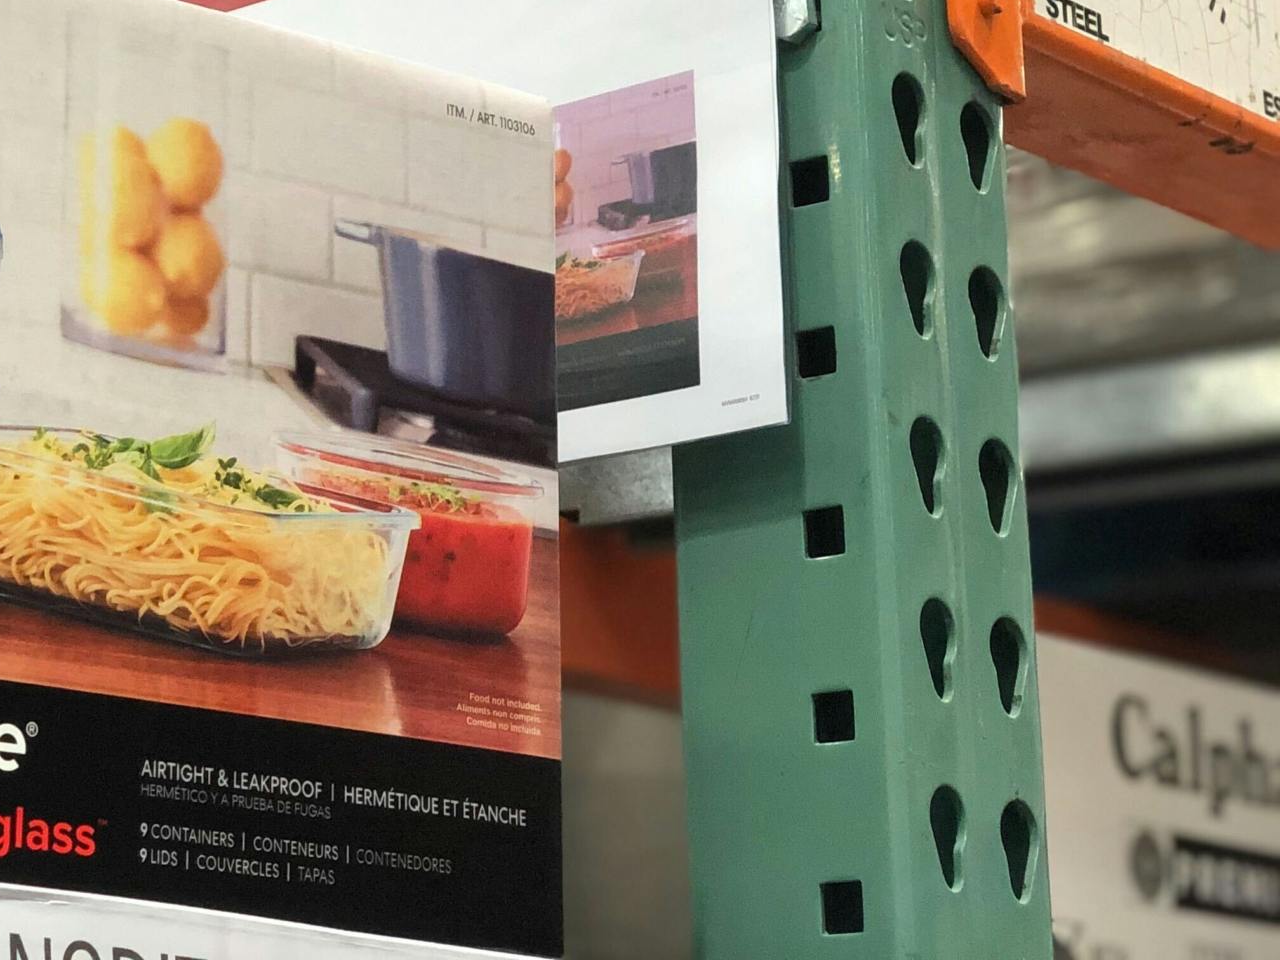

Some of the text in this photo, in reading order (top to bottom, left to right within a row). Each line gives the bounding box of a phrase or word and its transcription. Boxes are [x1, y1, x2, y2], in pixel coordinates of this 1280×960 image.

[446, 103, 536, 136] ITM. / ART. 1103106
[456, 703, 491, 716] Aliments
[493, 710, 507, 719] non
[469, 692, 490, 703] Food
[492, 696, 505, 705] not
[466, 716, 497, 729] Comida
[498, 722, 509, 731] no
[140, 783, 332, 820] HERMÉTICO Y A PRUEBA DE FUGAS
[141, 759, 527, 827] AIRTIGHT & LEAKPROOF HERMÉTIQUE ET ÉTANCHE
[140, 822, 452, 875] 9 CONTAINERS CONTENEURS CONTENEDORES
[139, 848, 336, 886] 9 LIDS COUVERCLES TAPAS
